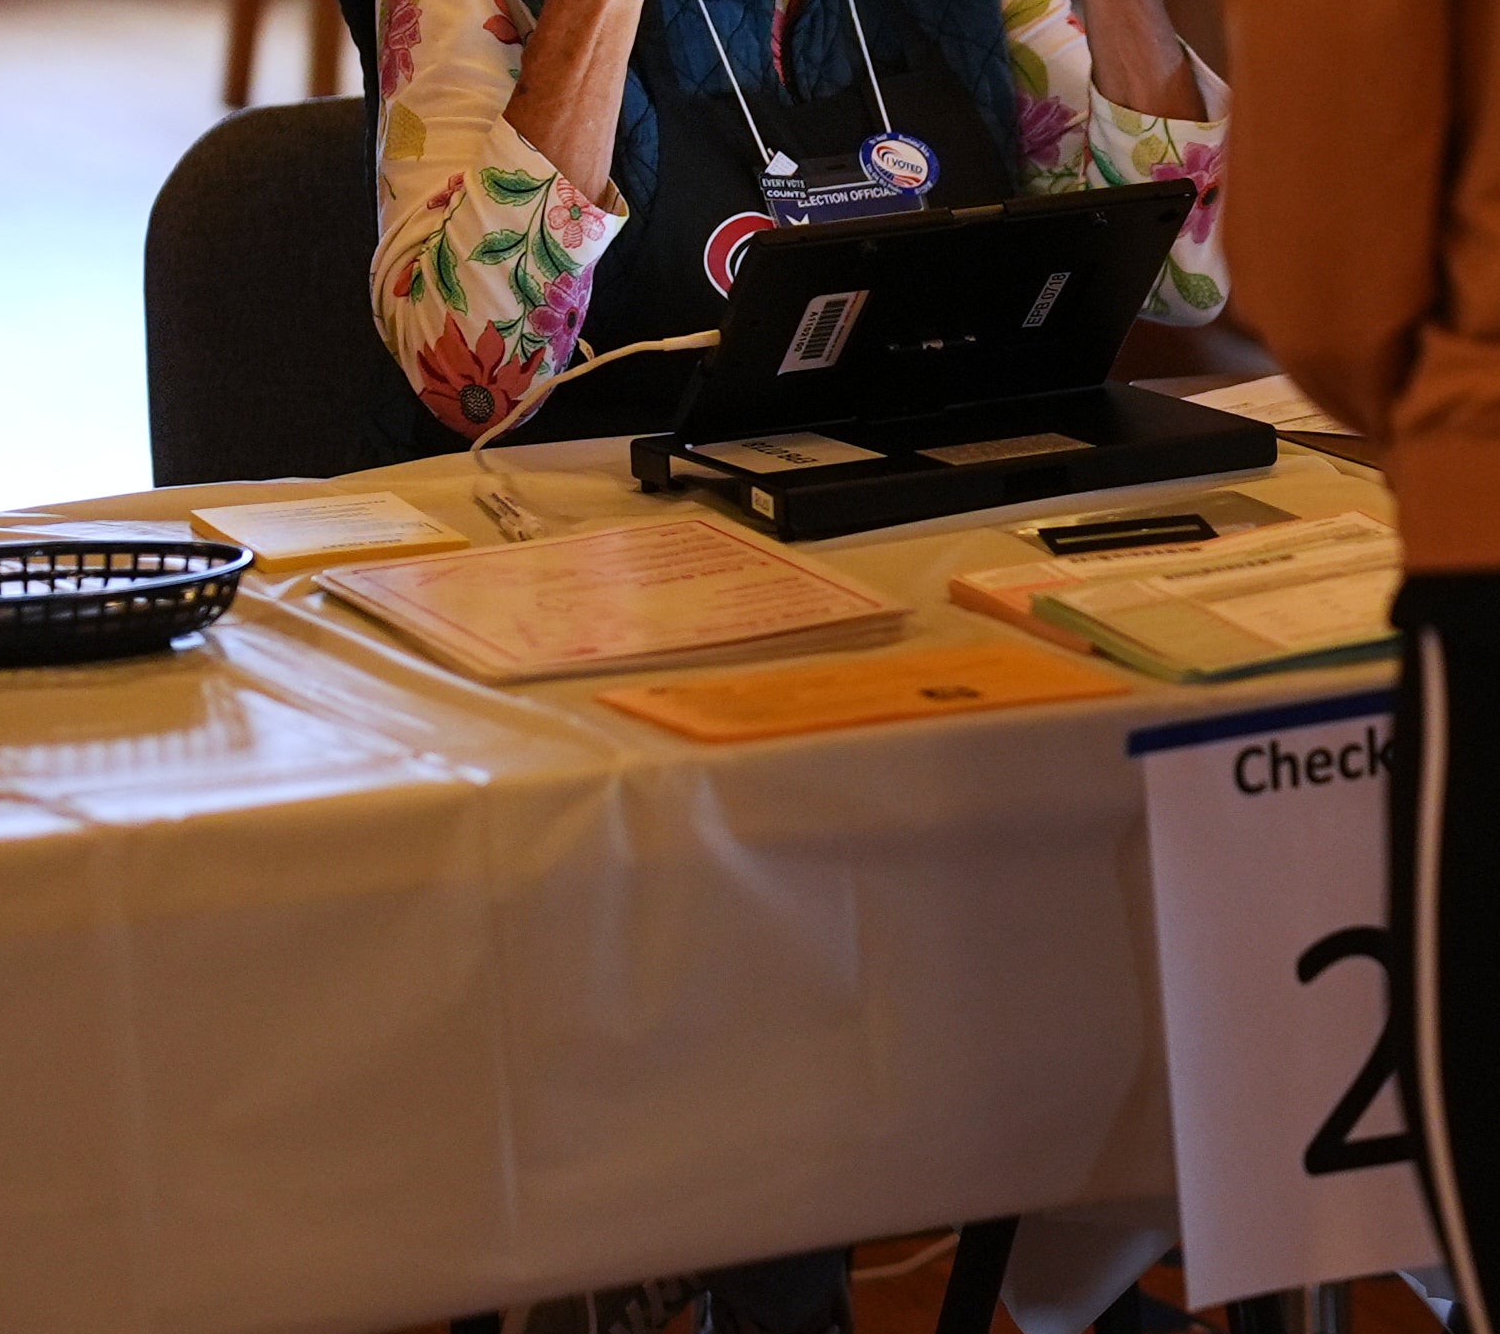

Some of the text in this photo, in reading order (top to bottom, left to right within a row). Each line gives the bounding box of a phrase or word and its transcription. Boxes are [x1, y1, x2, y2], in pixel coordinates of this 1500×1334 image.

[891, 157, 923, 175] VOTED
[761, 178, 785, 187] EVERY
[766, 189, 806, 199] COUNTS
[850, 186, 897, 201] OFFICIA
[1026, 273, 1068, 325] EPB 0718
[1297, 926, 1415, 1176] 2
